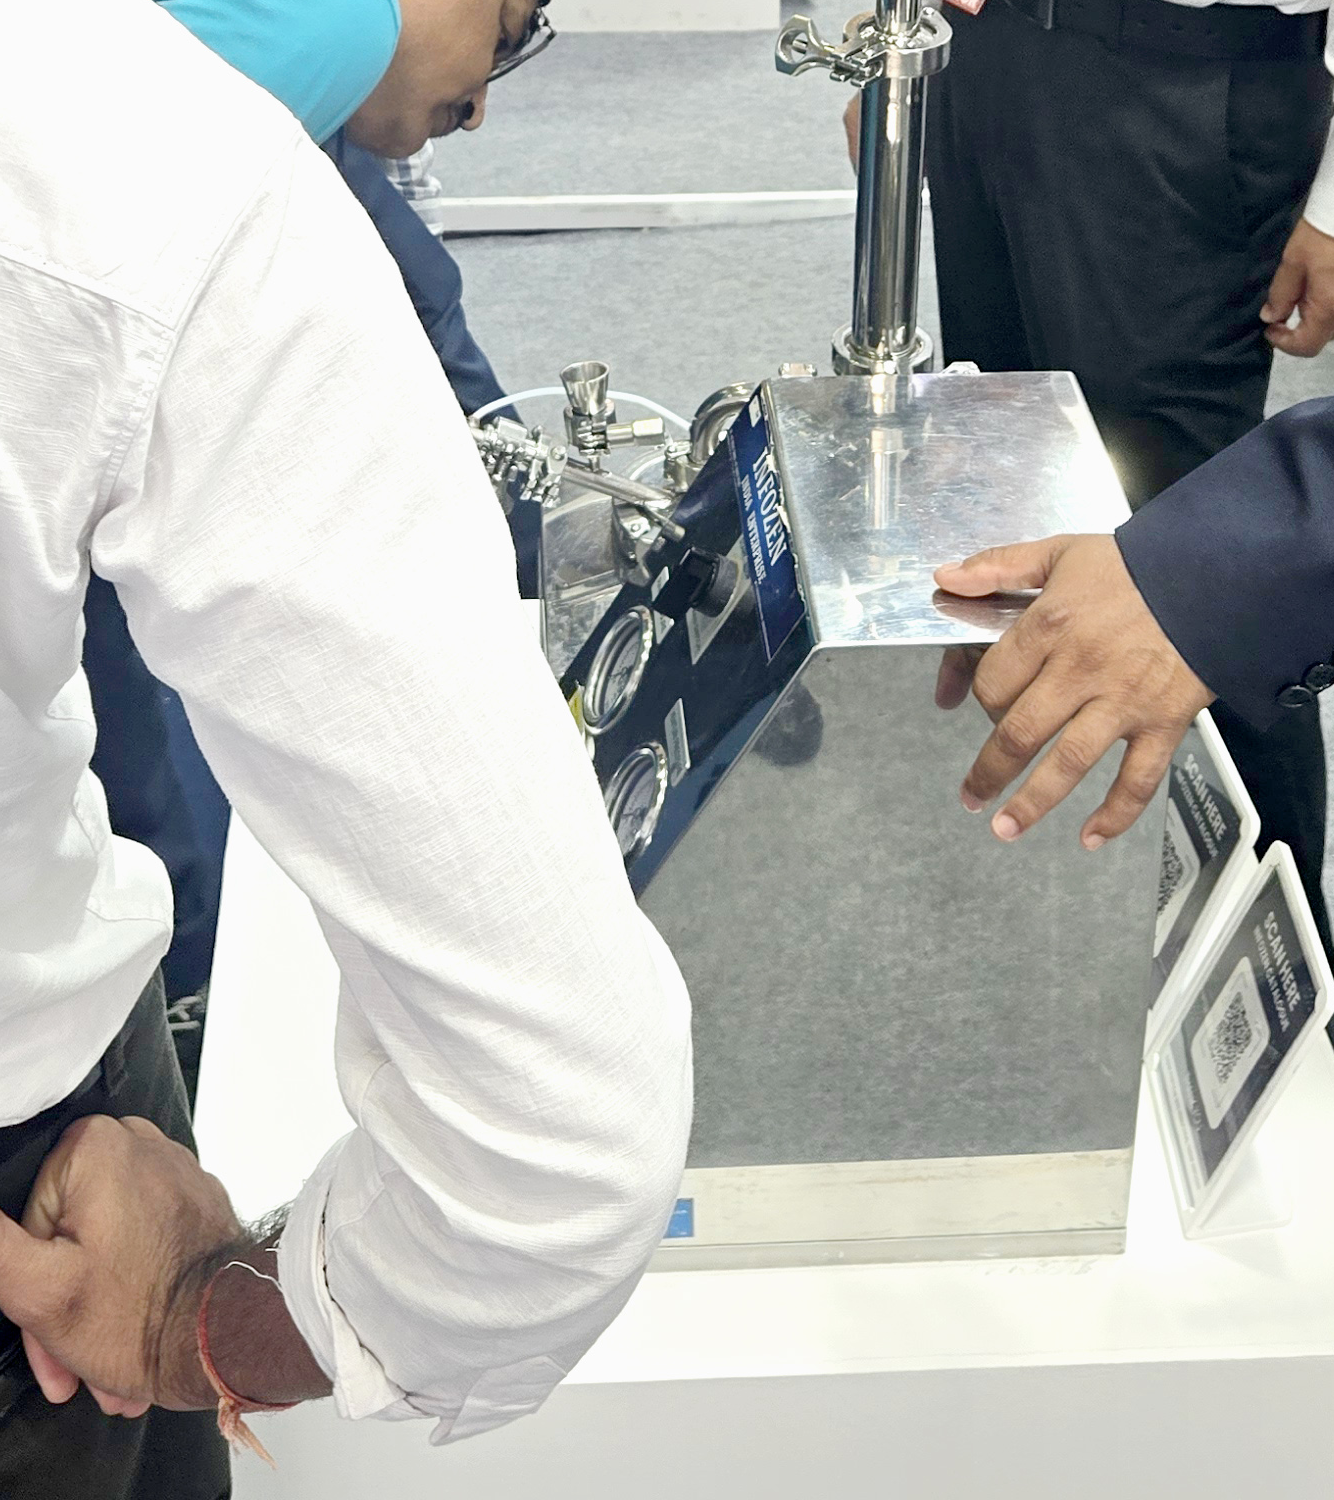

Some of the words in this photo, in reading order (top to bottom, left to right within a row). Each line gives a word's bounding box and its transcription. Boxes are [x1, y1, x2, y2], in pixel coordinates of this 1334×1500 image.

[740, 473, 754, 512] INDIA
[752, 445, 788, 567] INFOZEN
[1184, 753, 1210, 803] SCAN
[1203, 794, 1228, 841] HERE
[1263, 910, 1287, 967] SCAN
[1278, 959, 1302, 1013] HERE
